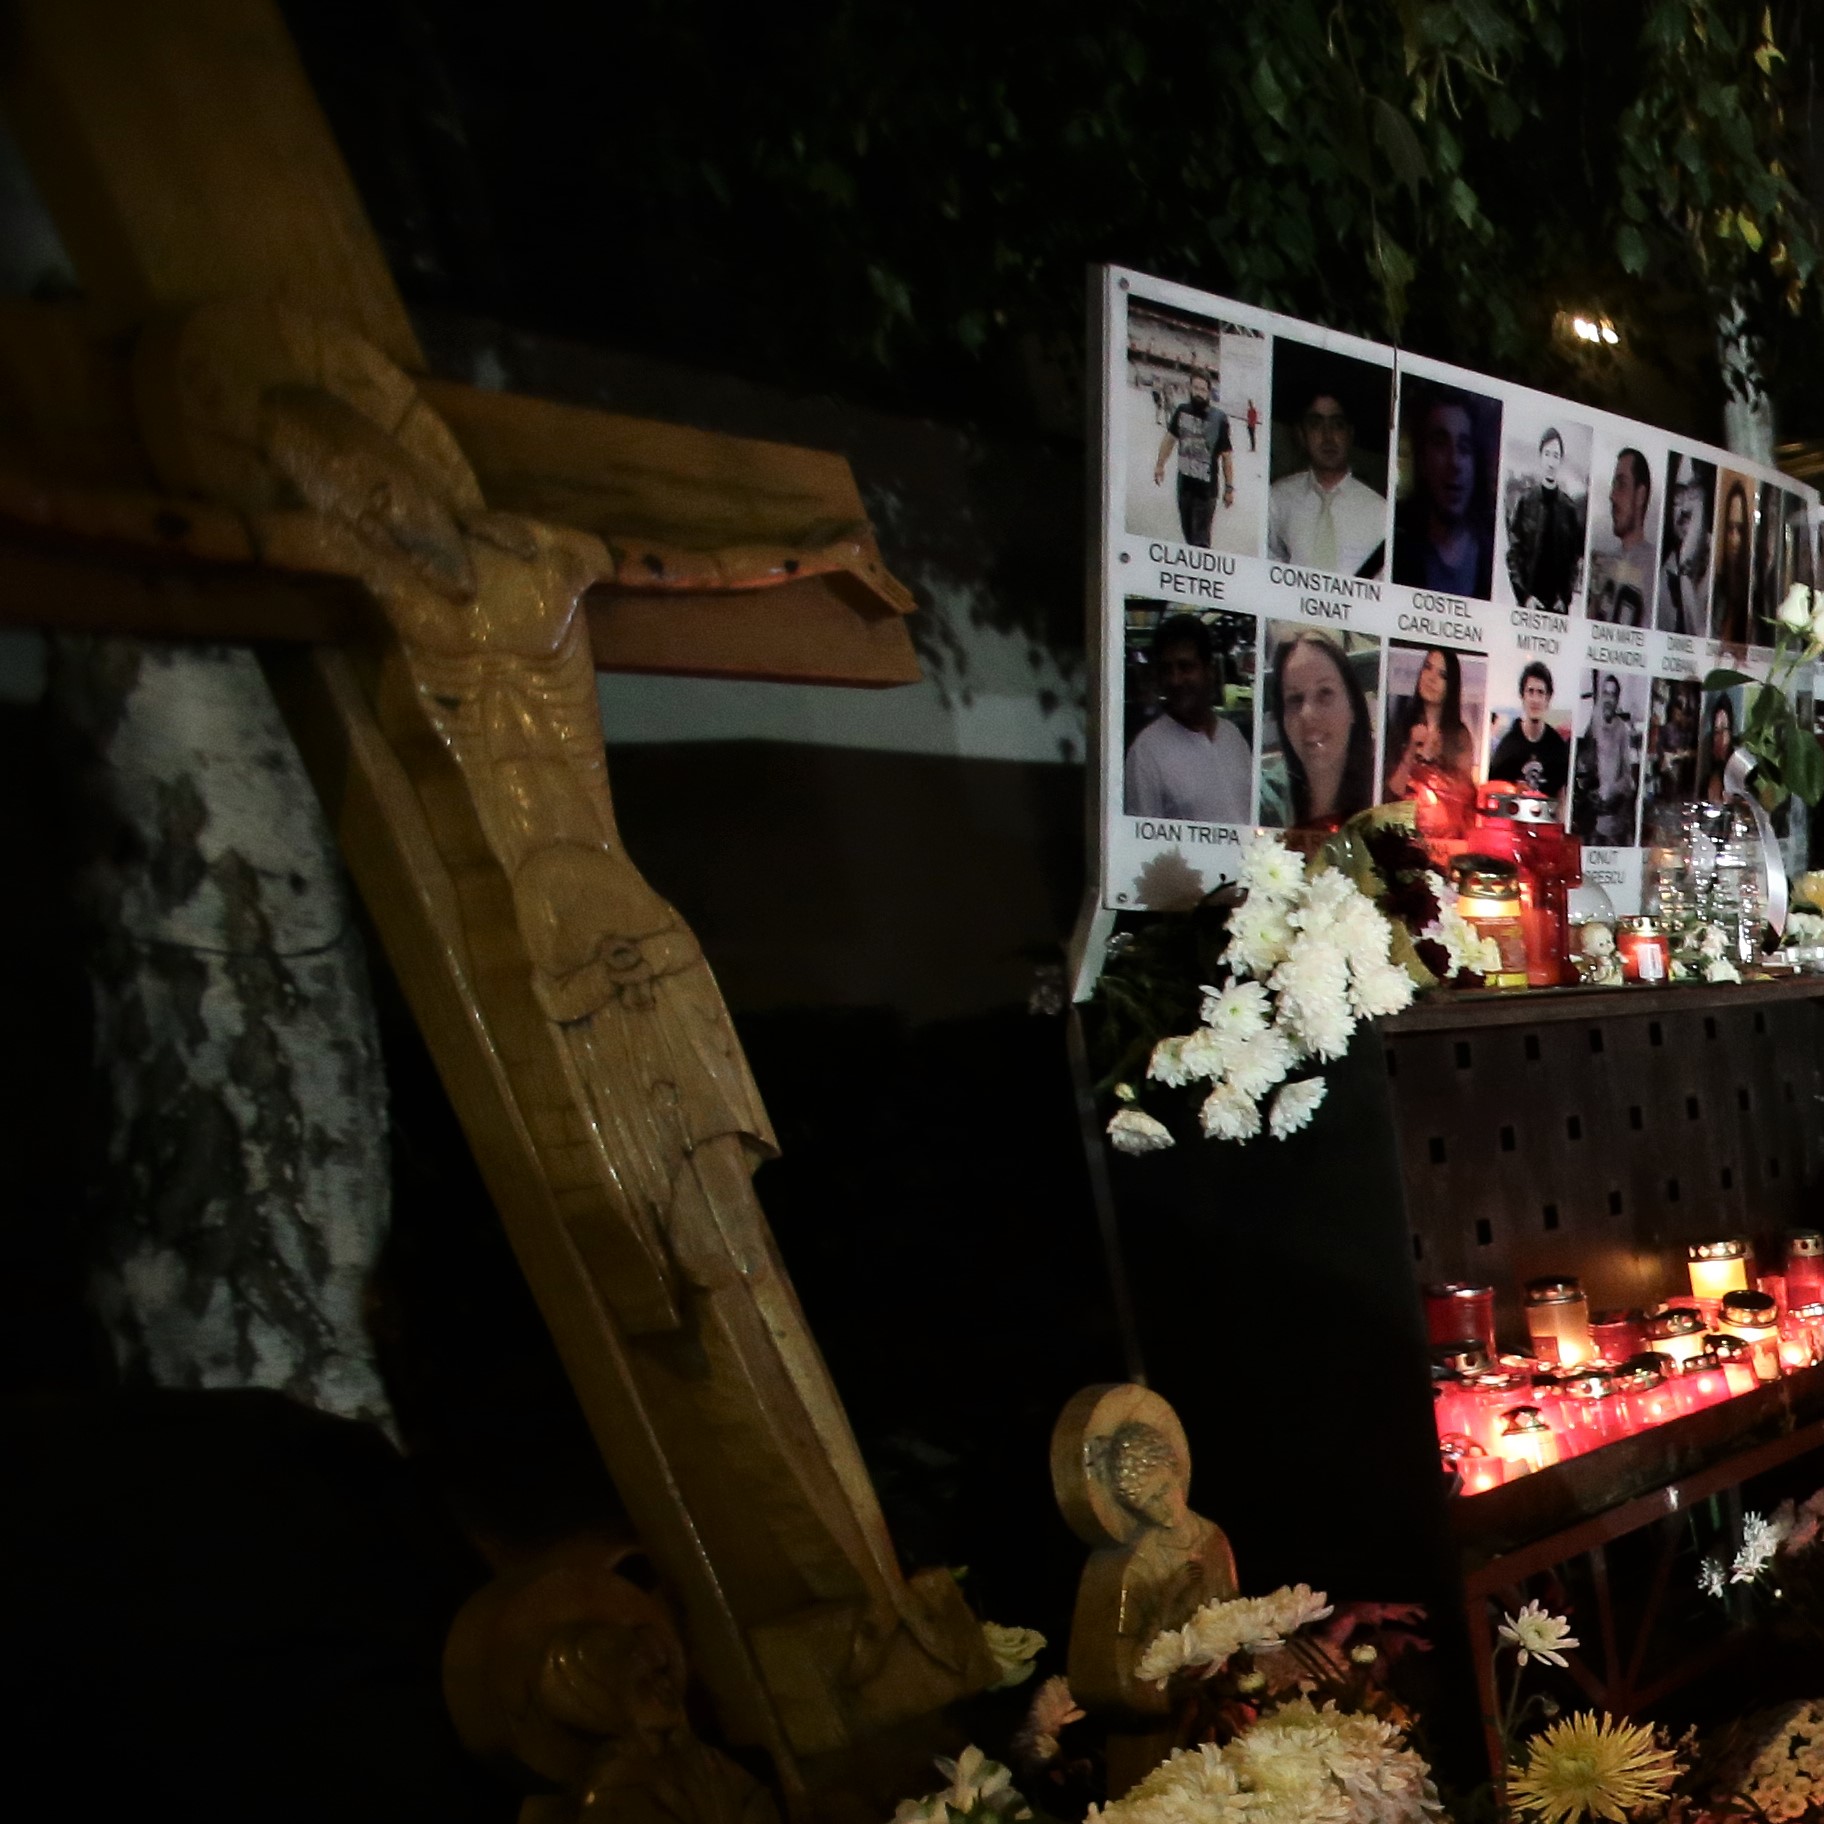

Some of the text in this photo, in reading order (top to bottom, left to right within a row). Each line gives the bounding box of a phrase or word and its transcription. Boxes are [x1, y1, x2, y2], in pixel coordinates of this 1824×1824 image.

[1149, 542, 1236, 576] CLAUDIU
[1159, 571, 1225, 600] PETRE
[1269, 565, 1382, 602] CONSTANTIN
[1300, 597, 1352, 621] IGNAT
[1412, 592, 1472, 619] COSTEL
[1397, 613, 1483, 643] CARLICEAN
[1510, 609, 1569, 634] CRISTIAN
[1516, 633, 1561, 656] MITROI
[1135, 822, 1241, 847] IOAN TRIPA
